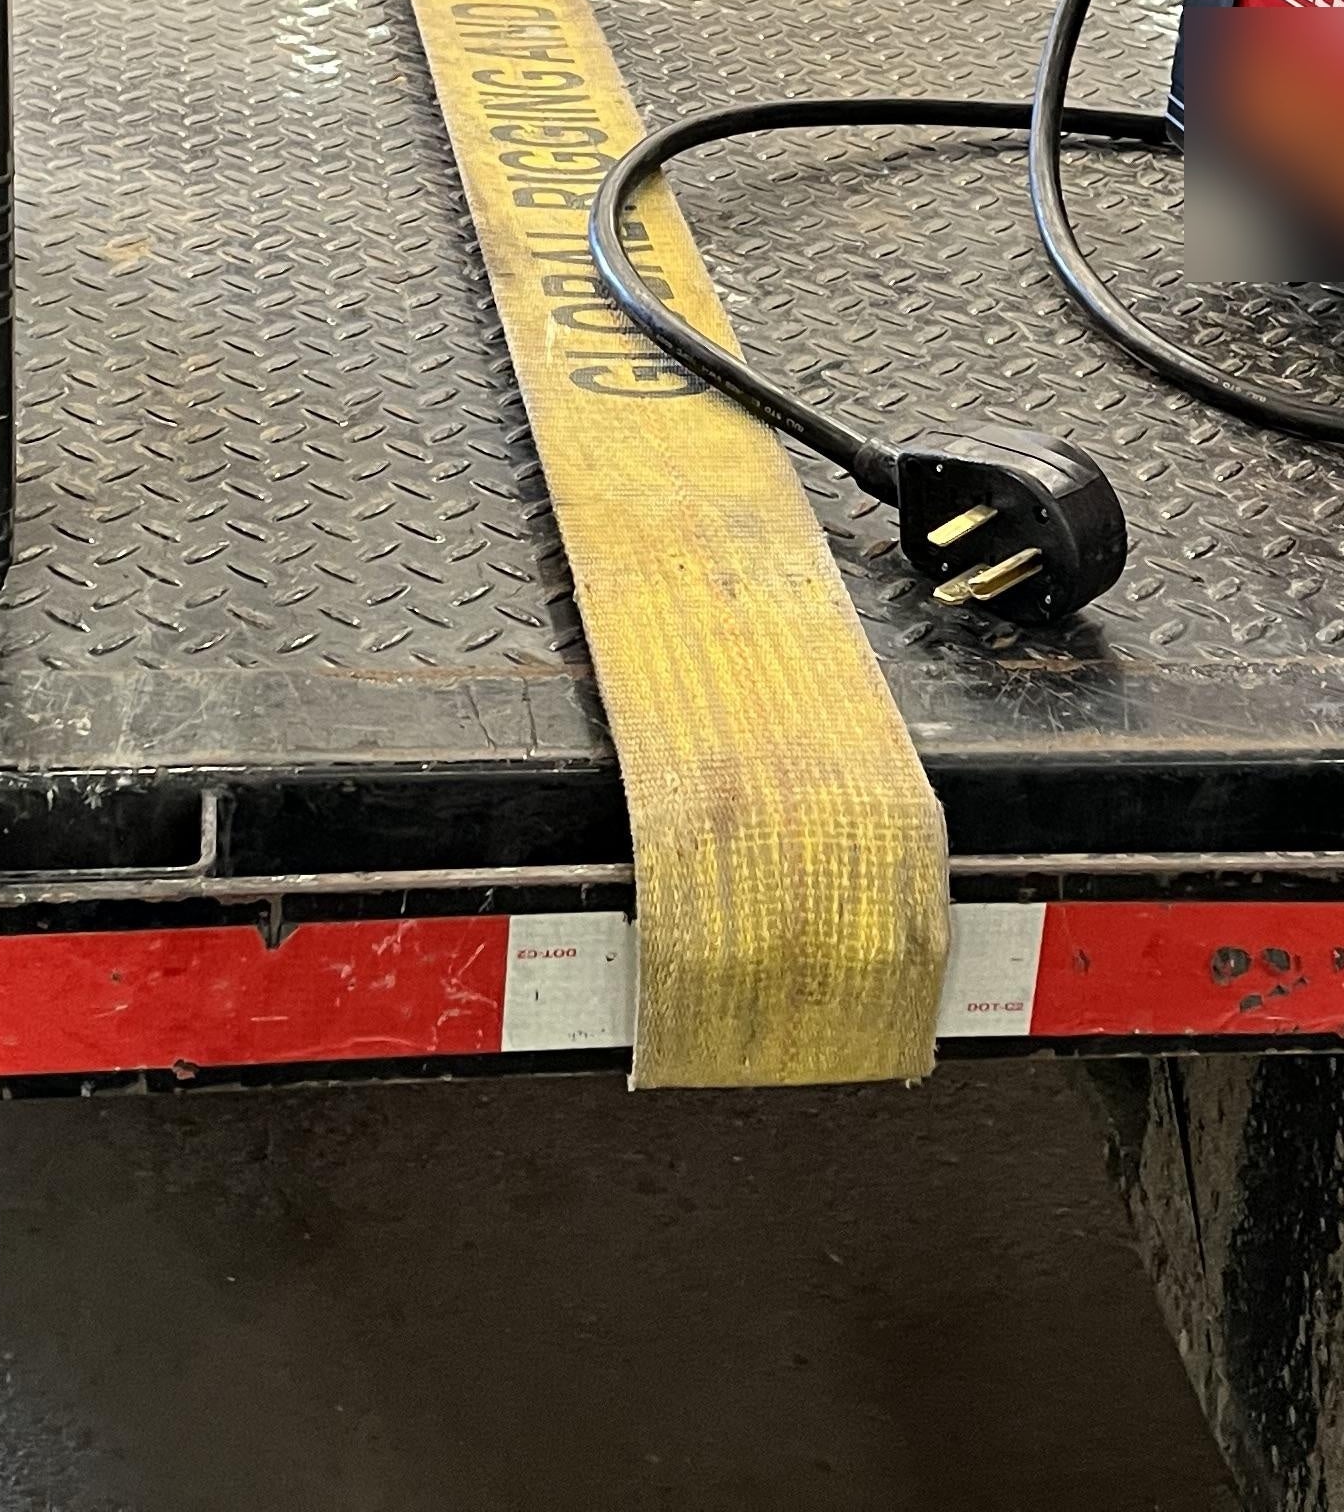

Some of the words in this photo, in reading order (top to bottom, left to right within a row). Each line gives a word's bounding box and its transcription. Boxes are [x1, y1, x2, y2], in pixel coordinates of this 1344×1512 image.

[454, 3, 575, 64] AND
[517, 948, 577, 960] DOT-C2
[967, 1002, 1024, 1012] DOT-C2
